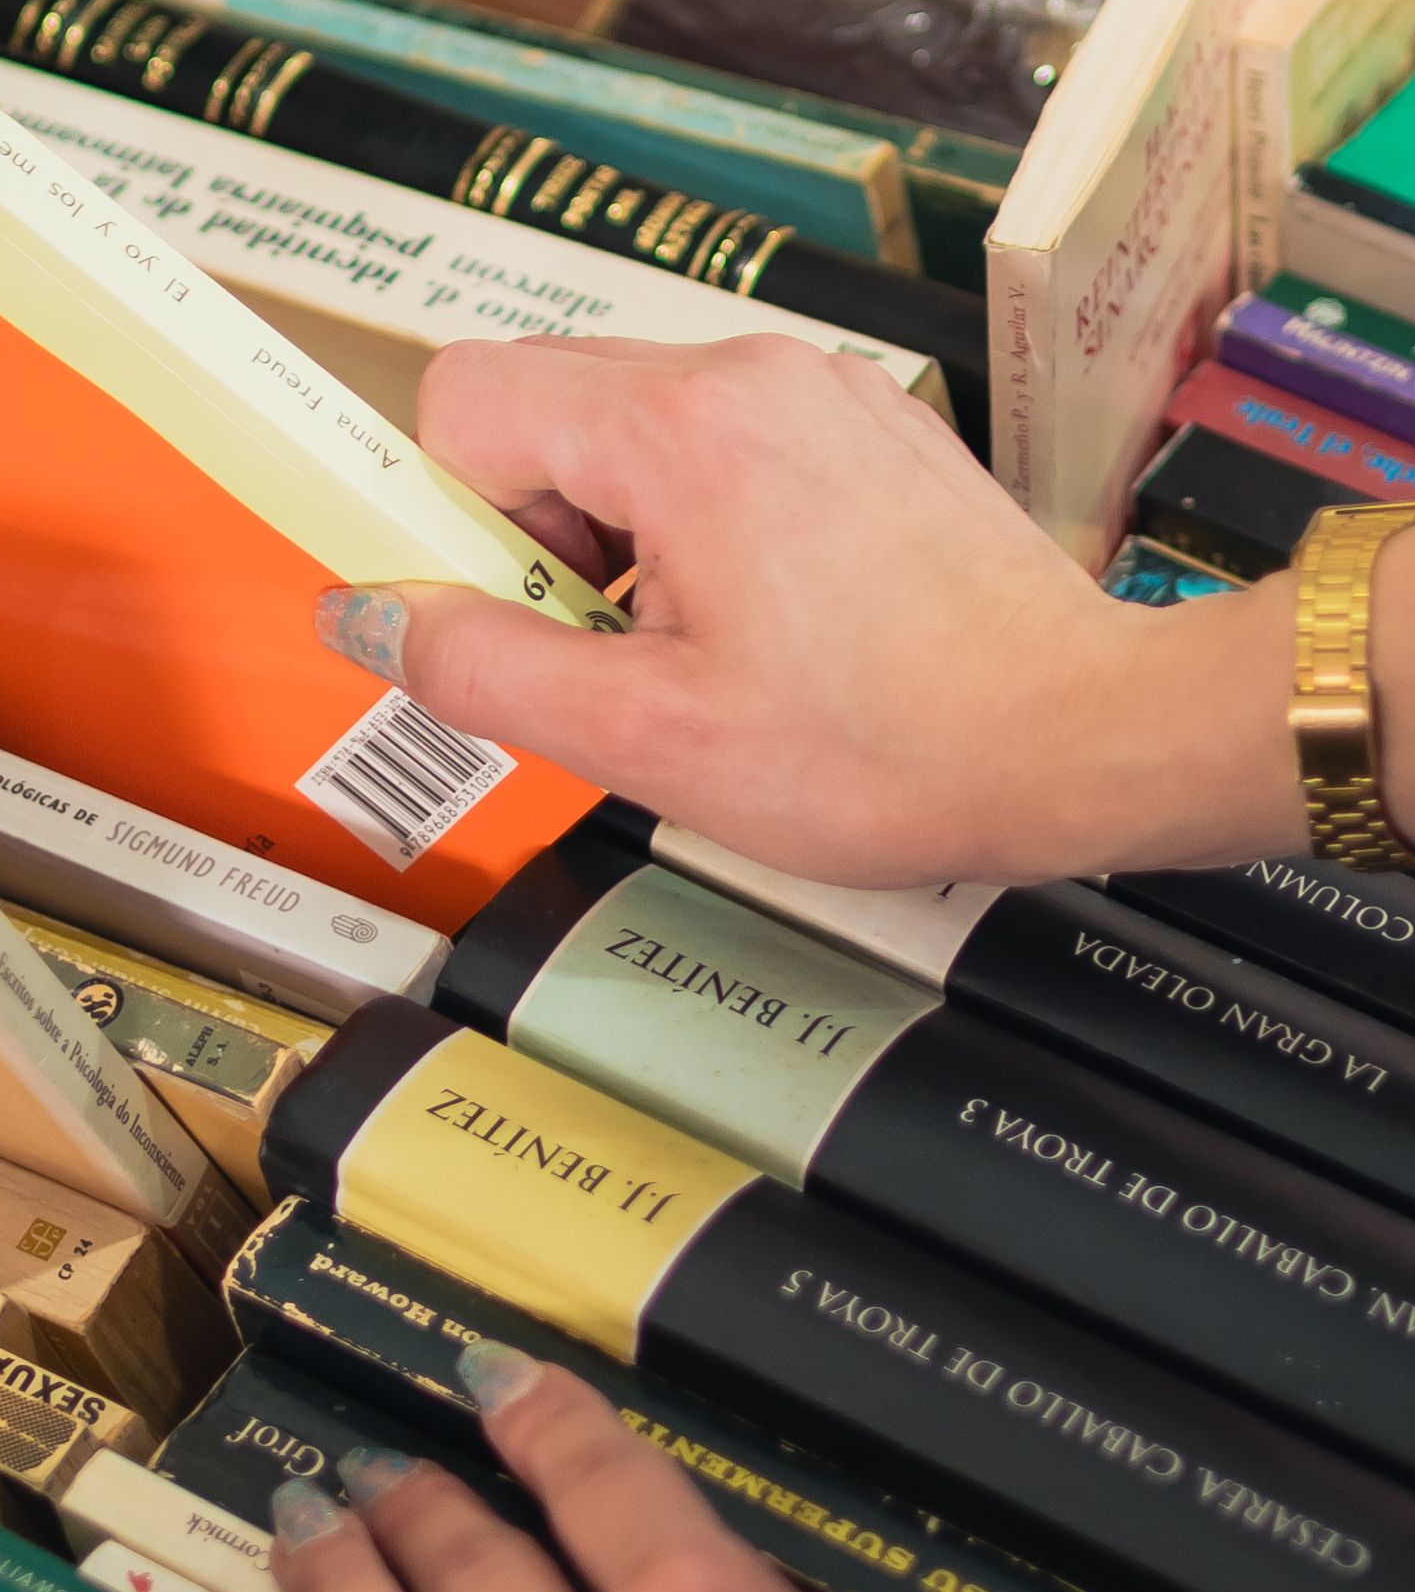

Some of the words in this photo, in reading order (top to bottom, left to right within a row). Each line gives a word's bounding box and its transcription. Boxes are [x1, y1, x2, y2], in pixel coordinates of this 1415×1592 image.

[41, 178, 83, 217] los
[93, 213, 117, 238] y
[120, 235, 160, 273] yo
[161, 274, 191, 304] El
[248, 345, 324, 411] Freud
[329, 410, 400, 473] Anna
[518, 557, 560, 604] 67
[73, 805, 100, 828] DE
[104, 815, 217, 884] SIGMUND
[218, 861, 303, 918] FREUD
[597, 921, 792, 1032] BENÍTEZ
[1068, 930, 1218, 1017] OLEADA
[792, 1005, 855, 1061] J.J.
[1218, 997, 1336, 1069] GRAN
[1339, 1050, 1389, 1092] LA
[419, 1083, 613, 1201] BENÍTEZ
[957, 1091, 989, 1129] 3
[989, 1107, 1116, 1187] TROYA
[615, 1170, 680, 1228] J.J.
[1116, 1168, 1177, 1218] DE
[778, 1261, 814, 1300] 5
[1176, 1197, 1359, 1304] CABALLO
[307, 1248, 438, 1331] Howard
[809, 1277, 942, 1362] TROYA
[943, 1344, 1004, 1394] DE
[222, 1406, 332, 1483] Grof
[1001, 1373, 1187, 1485] CABALLO
[608, 1402, 919, 1579] SUPERMENTE
